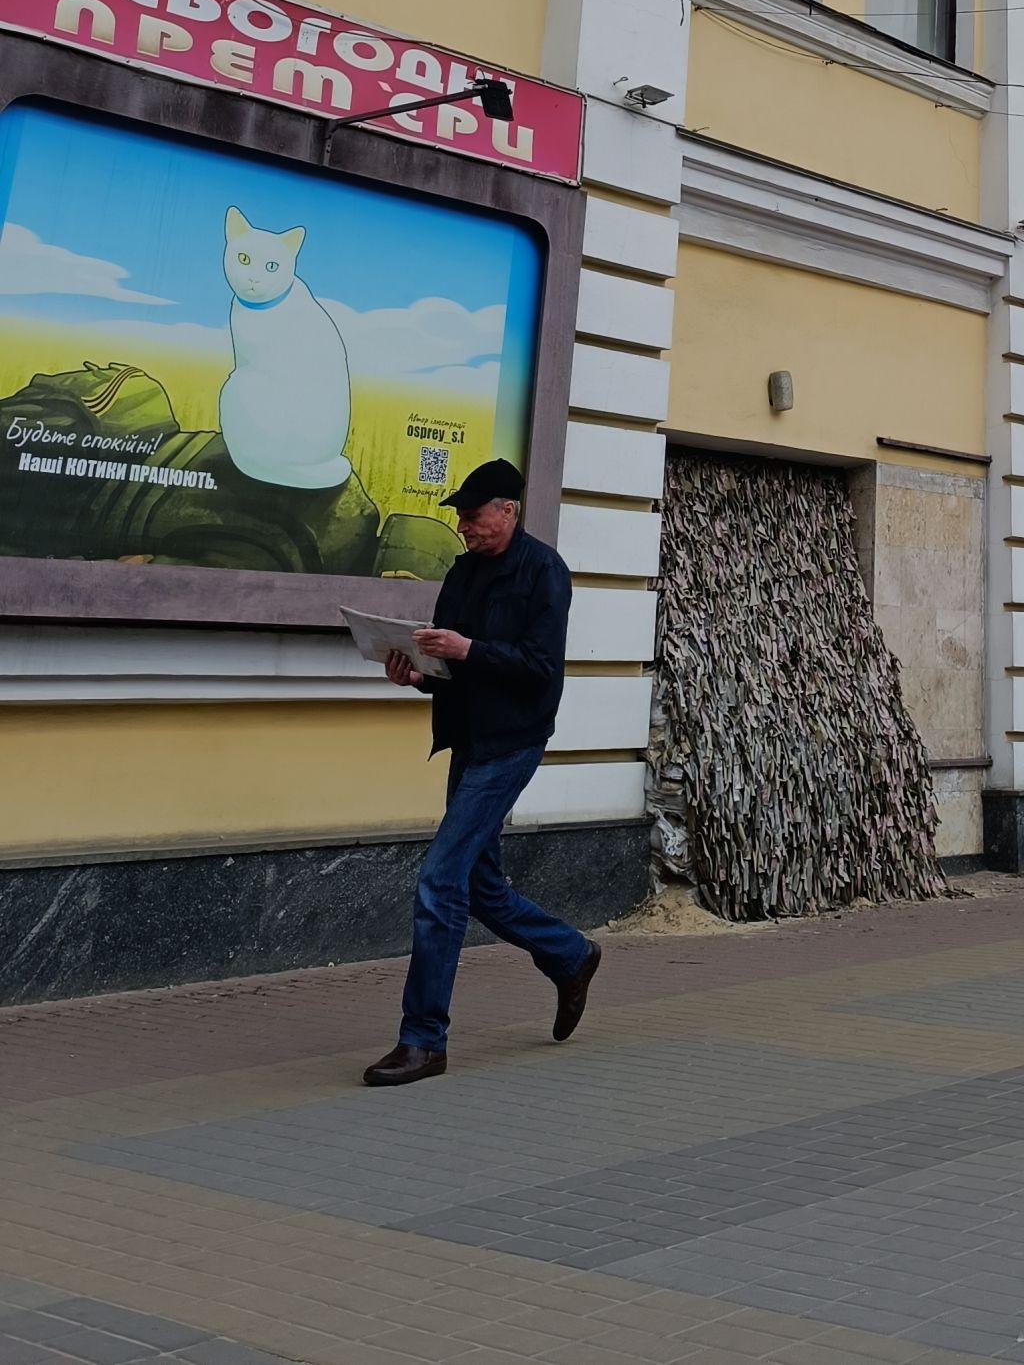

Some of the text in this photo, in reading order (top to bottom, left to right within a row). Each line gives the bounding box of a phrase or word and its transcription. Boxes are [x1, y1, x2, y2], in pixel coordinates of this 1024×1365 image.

[6, 416, 164, 456] Будьте спокійні!
[18, 452, 218, 491] Наші КОТИКИ ПРАЦЮЮТЬ.
